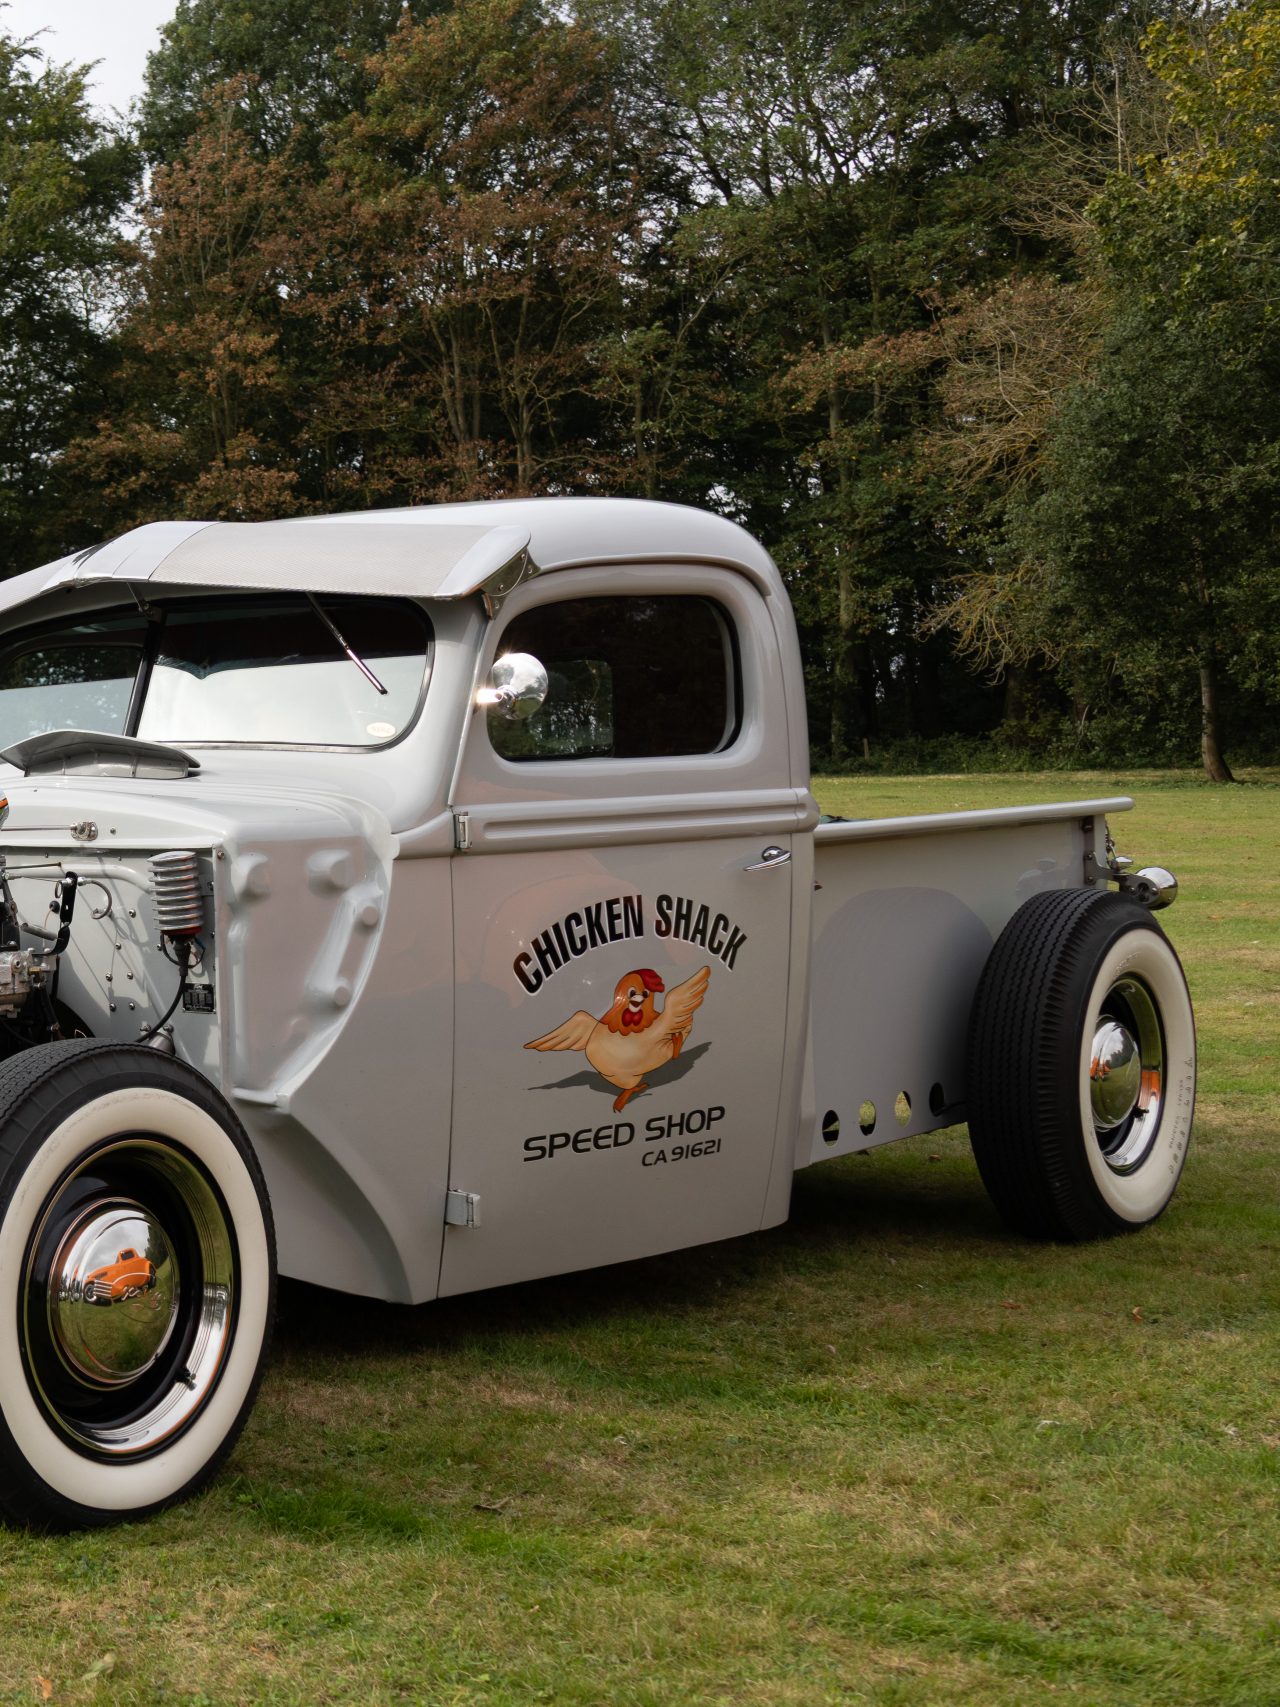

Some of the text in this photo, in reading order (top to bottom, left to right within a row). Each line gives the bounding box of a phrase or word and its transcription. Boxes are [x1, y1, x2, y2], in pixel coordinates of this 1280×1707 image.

[513, 894, 748, 995] CHICKEN SHACK
[523, 1105, 726, 1162] SPEED SHOP
[641, 1138, 722, 1167] CA 91621
